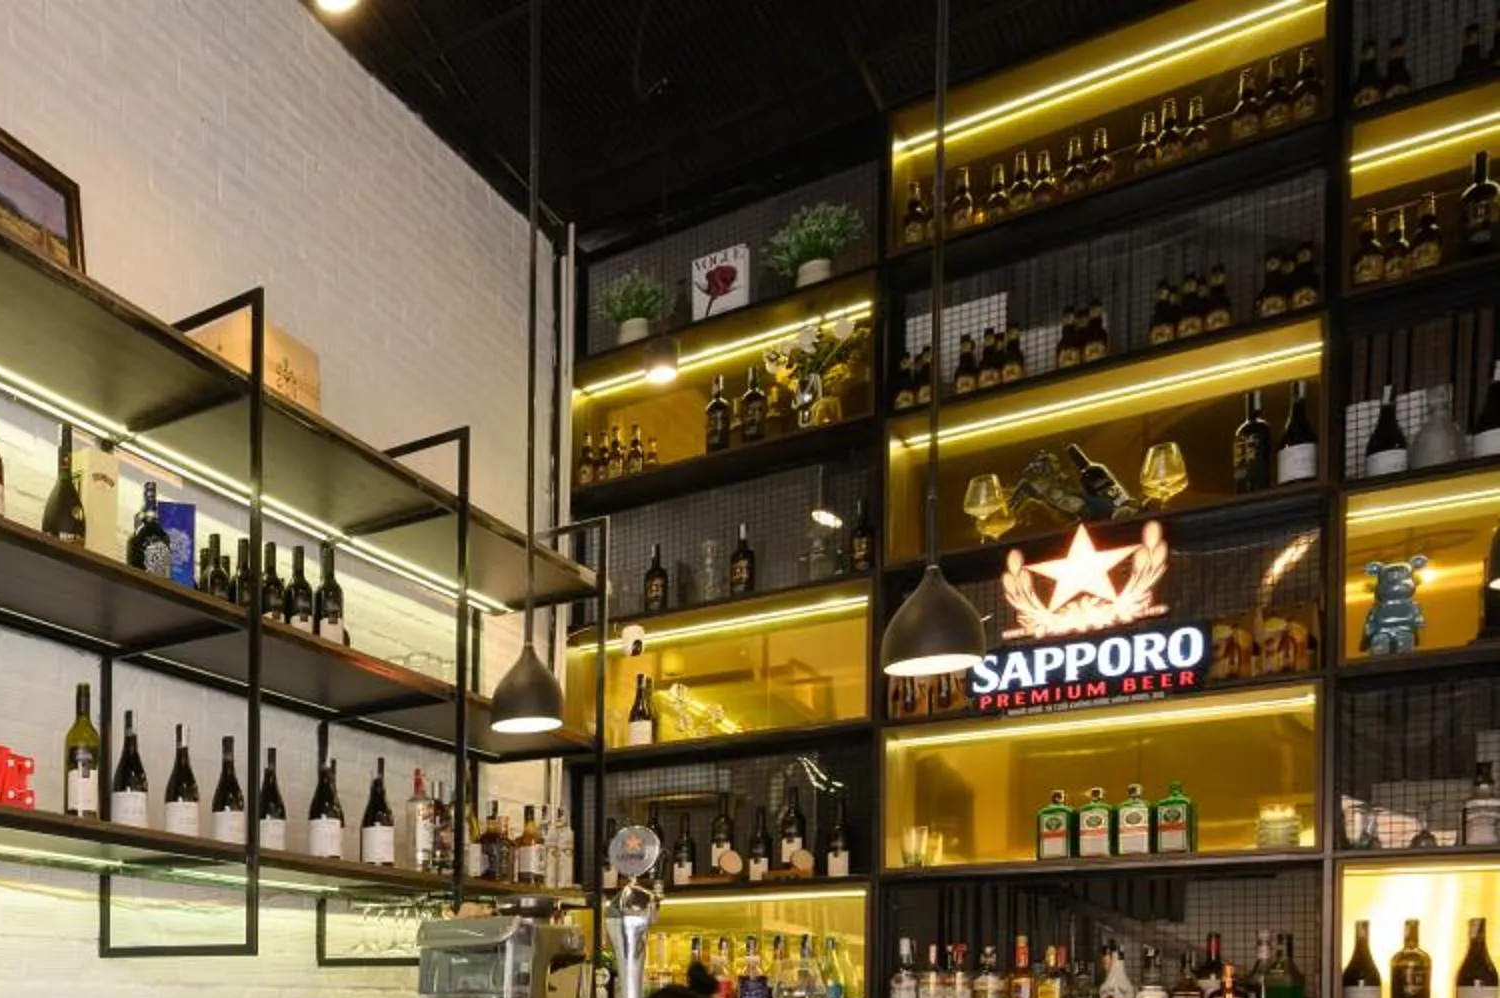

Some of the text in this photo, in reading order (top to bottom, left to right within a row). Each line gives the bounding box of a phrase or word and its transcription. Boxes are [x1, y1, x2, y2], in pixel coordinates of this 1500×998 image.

[972, 626, 1204, 694] SAPPORO
[979, 681, 1108, 710] PREMIUM
[1123, 672, 1196, 693] BEER
